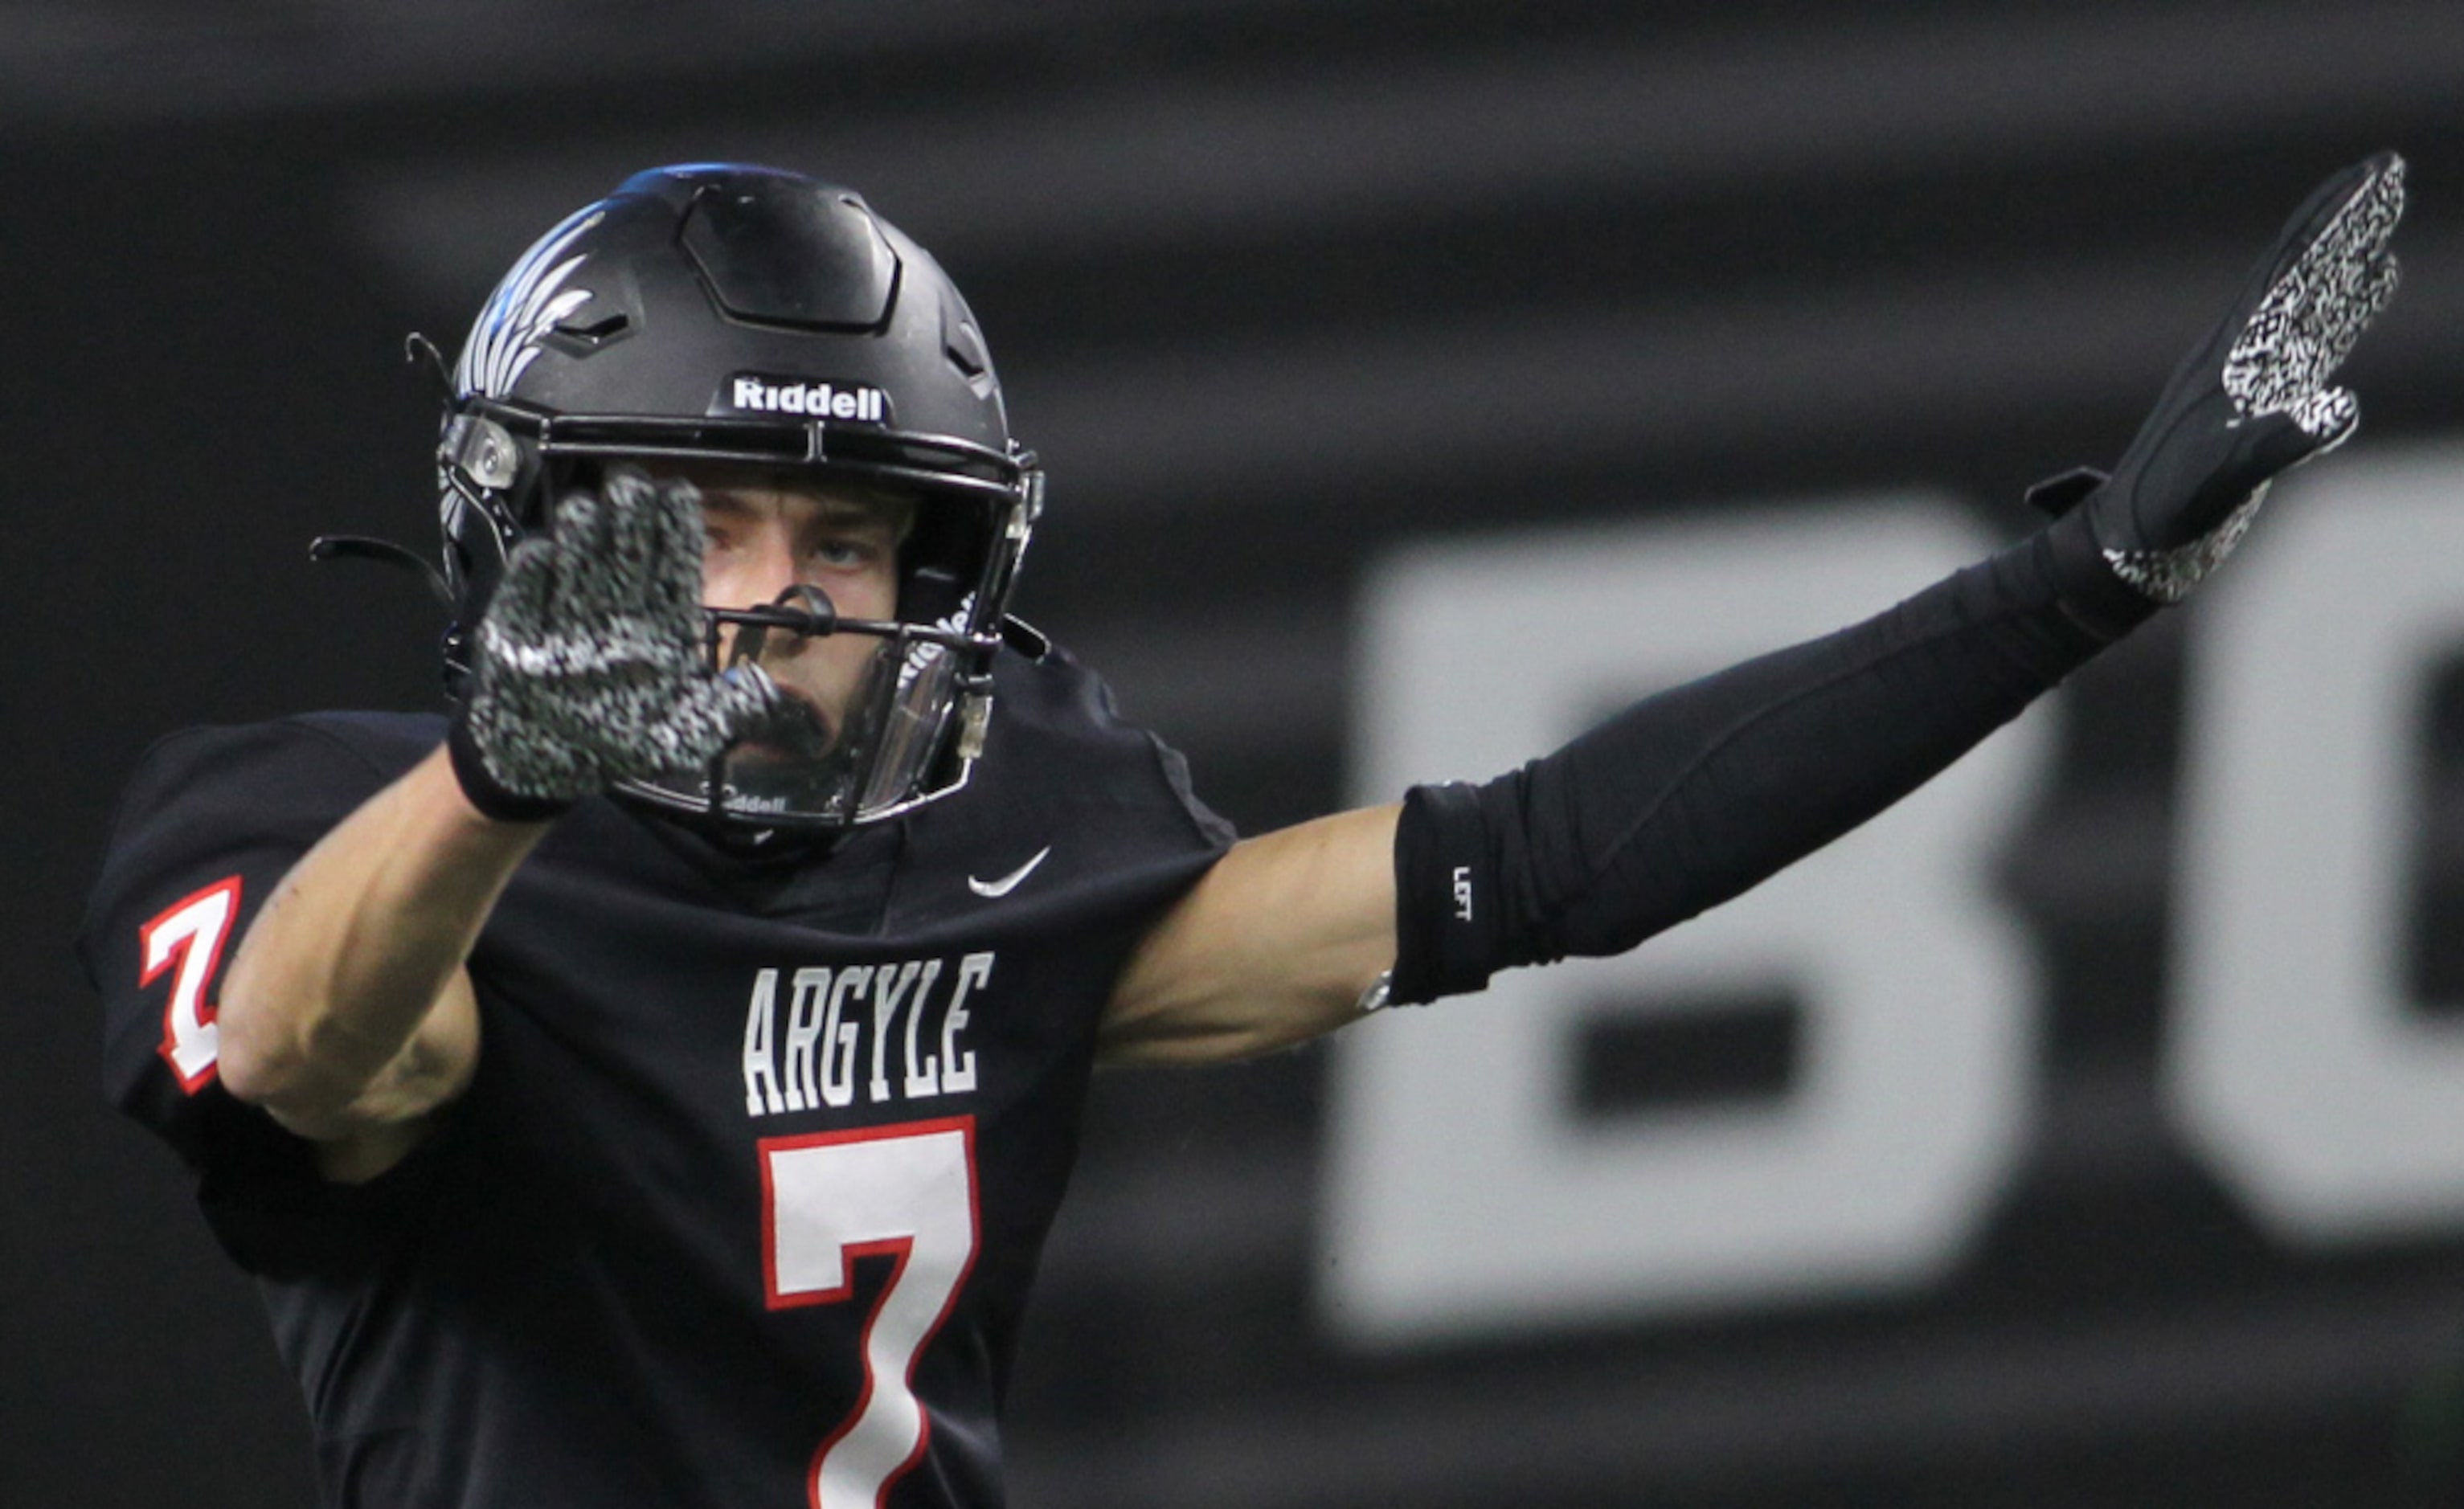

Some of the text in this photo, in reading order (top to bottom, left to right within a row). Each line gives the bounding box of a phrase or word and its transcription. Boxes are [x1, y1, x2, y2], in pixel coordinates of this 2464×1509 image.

[732, 377, 882, 421] Riddell
[1453, 866, 1472, 922] LEFT
[139, 873, 244, 1095] 7
[743, 951, 996, 1118] ARGYLE
[756, 1114, 982, 1509] 7
